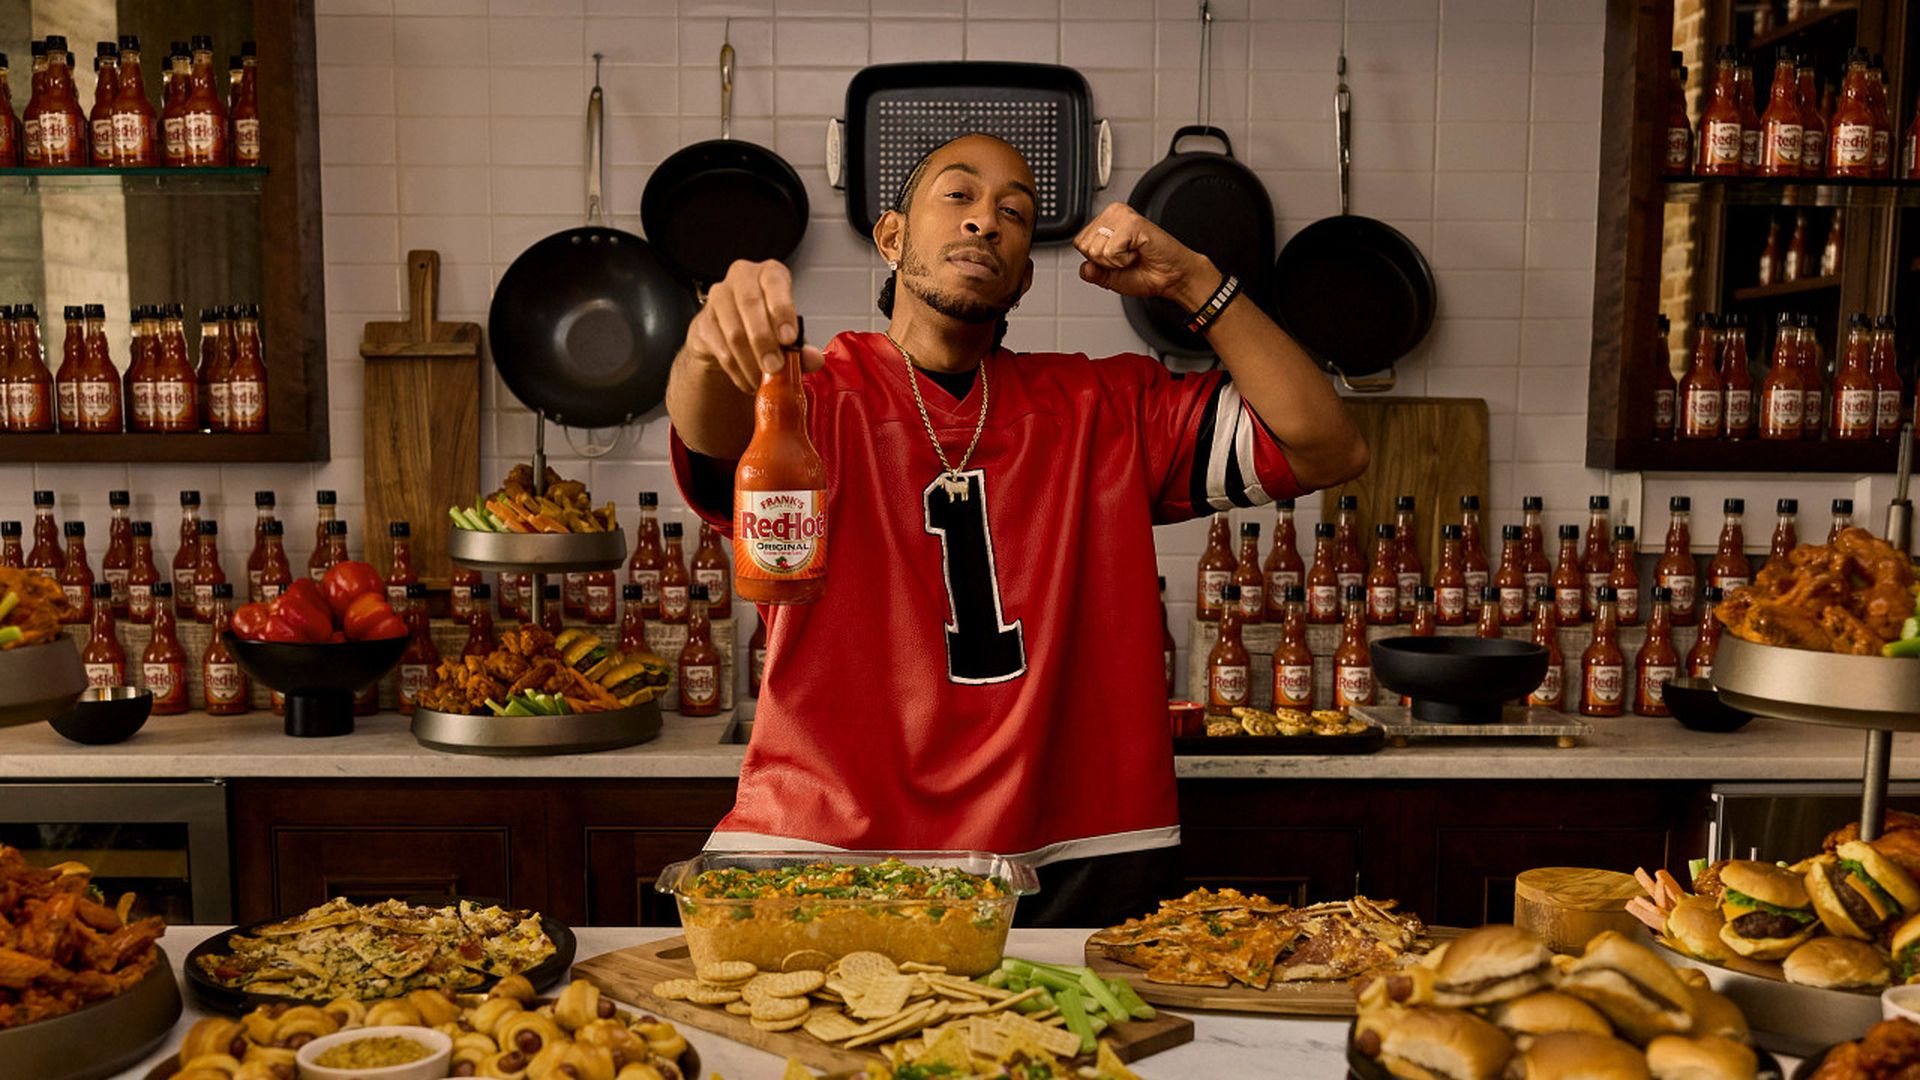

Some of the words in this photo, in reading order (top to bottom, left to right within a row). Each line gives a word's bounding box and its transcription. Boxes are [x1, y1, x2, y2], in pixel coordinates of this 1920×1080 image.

[760, 495, 805, 509] FRANK'S
[741, 511, 825, 540] RedHot
[757, 542, 809, 551] ORIGINAL
[923, 468, 1027, 685] 1
